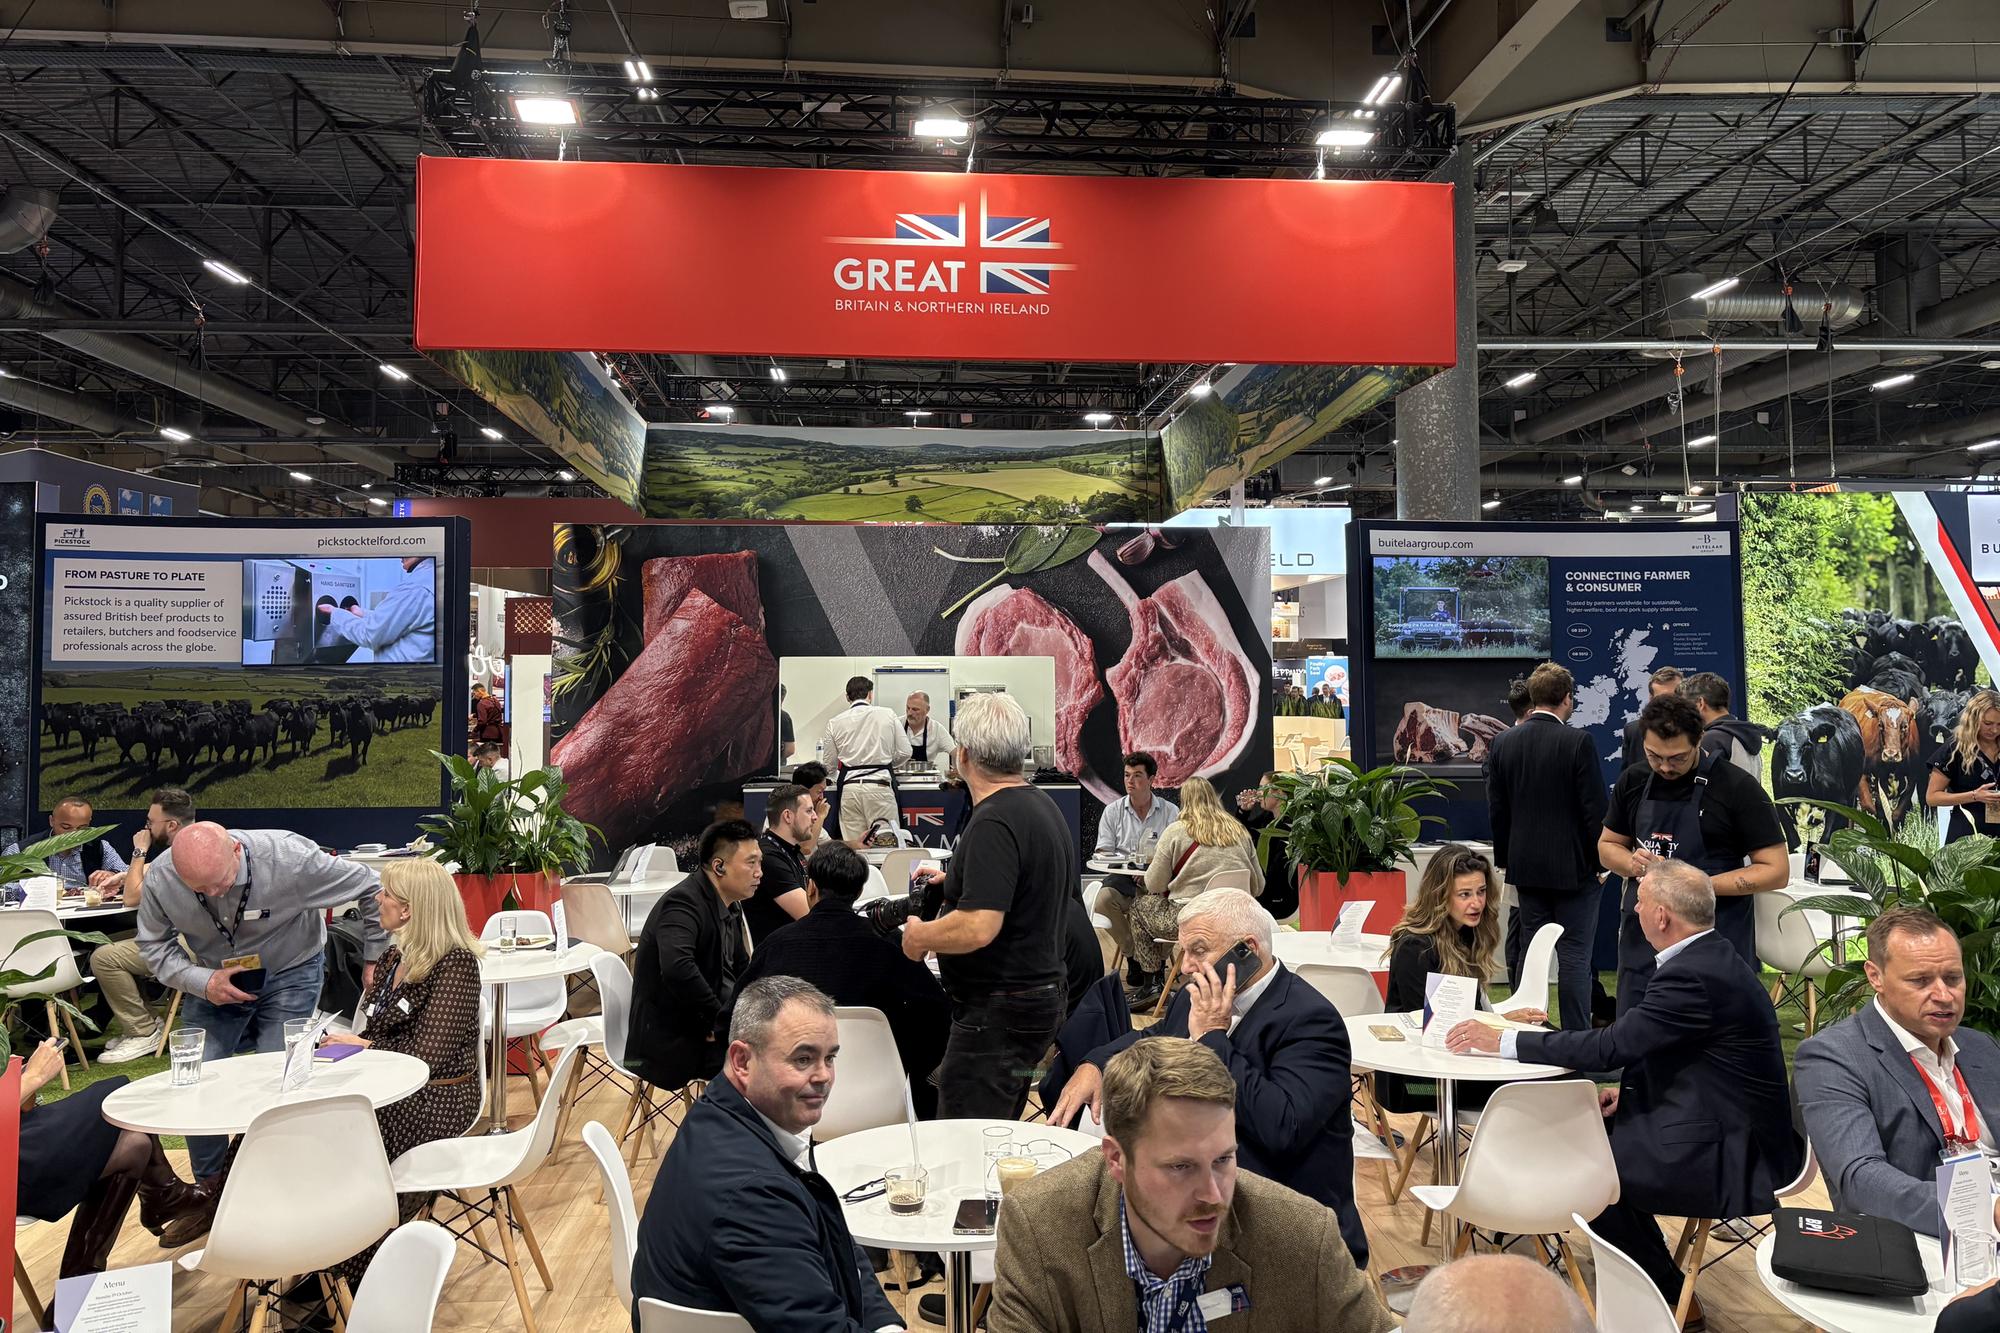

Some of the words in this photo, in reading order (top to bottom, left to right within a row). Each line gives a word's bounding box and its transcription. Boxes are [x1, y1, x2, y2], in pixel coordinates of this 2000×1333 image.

[833, 257, 965, 293] GREAT
[835, 300, 889, 312] BRITAIN
[893, 300, 904, 312] &
[907, 301, 984, 314] NORTHERN
[990, 303, 1050, 315] IRELAND
[317, 536, 426, 548] pickstocktelford.com
[1378, 538, 1473, 550] buitelaargroup.com
[64, 569, 97, 579] FROM
[100, 571, 150, 580] PASTURE
[153, 572, 168, 581] TO
[171, 572, 205, 581] PLATE
[1565, 571, 1641, 581] CONNECTING
[1644, 571, 1691, 580] FARMER
[1565, 583, 1574, 592] &
[1576, 583, 1642, 592] CONSUMER
[64, 596, 111, 607] Pickstock
[114, 597, 123, 607] is
[134, 598, 168, 609] quality
[171, 598, 210, 609] supplier
[213, 598, 224, 608] of
[63, 611, 101, 621] assured
[105, 612, 137, 622] British
[140, 612, 164, 622] beef
[166, 613, 210, 624] products
[213, 613, 224, 622] to
[63, 626, 106, 637] retailers,
[109, 626, 153, 637] butchers
[156, 627, 175, 637] and
[178, 627, 237, 637] foodservice
[63, 641, 128, 653] professionals
[131, 643, 163, 652] across
[166, 642, 183, 652] the
[185, 642, 217, 654] globe.
[1643, 840, 1679, 850] QUATY
[103, 1280, 126, 1289] Menu
